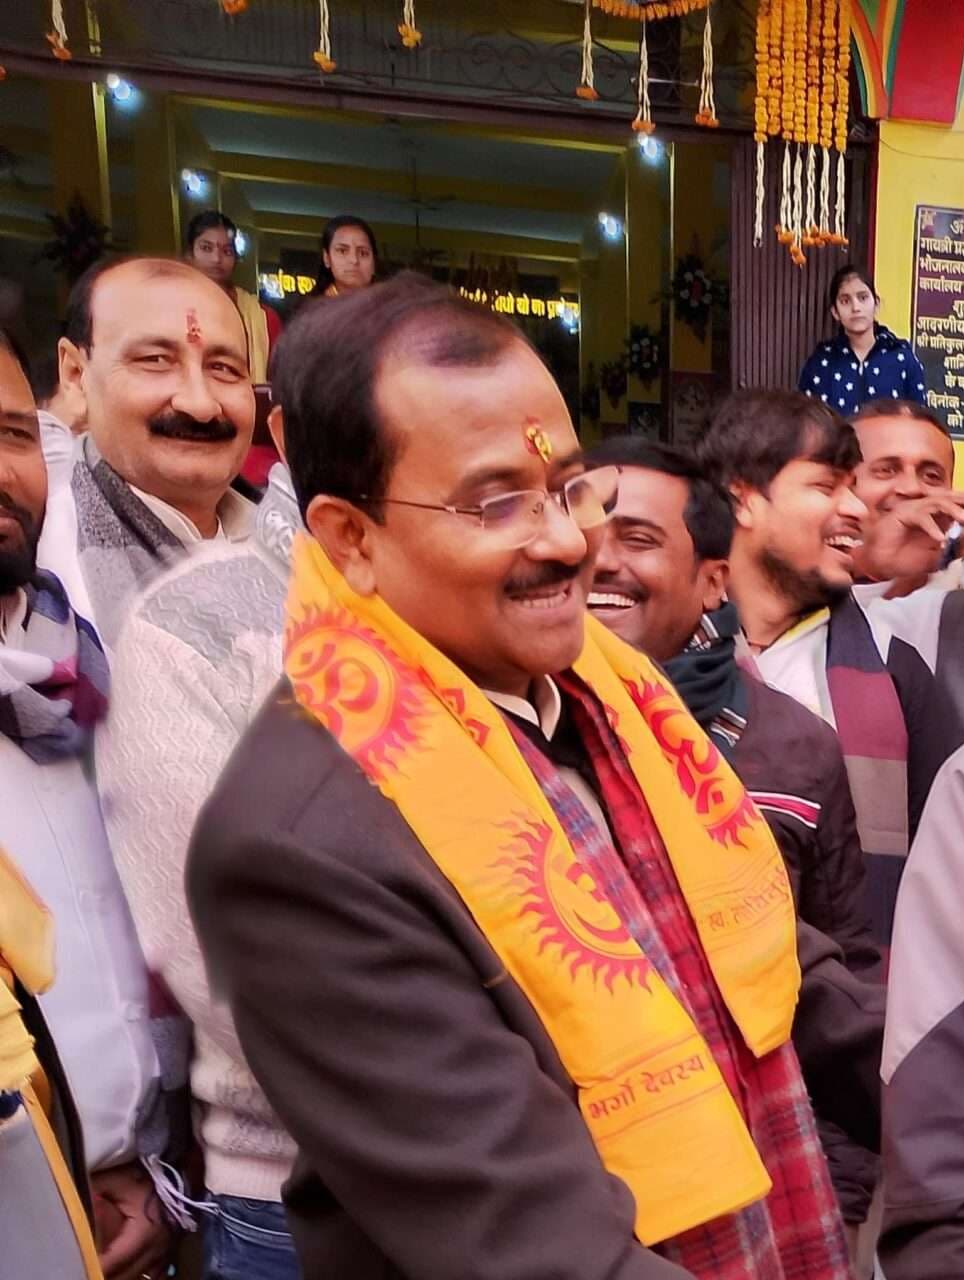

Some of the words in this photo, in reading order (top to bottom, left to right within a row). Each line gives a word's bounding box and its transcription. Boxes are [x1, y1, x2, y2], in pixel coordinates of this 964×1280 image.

[920, 237, 952, 254] गायत्री
[919, 276, 964, 294] कार्यालय
[947, 411, 964, 428] को
